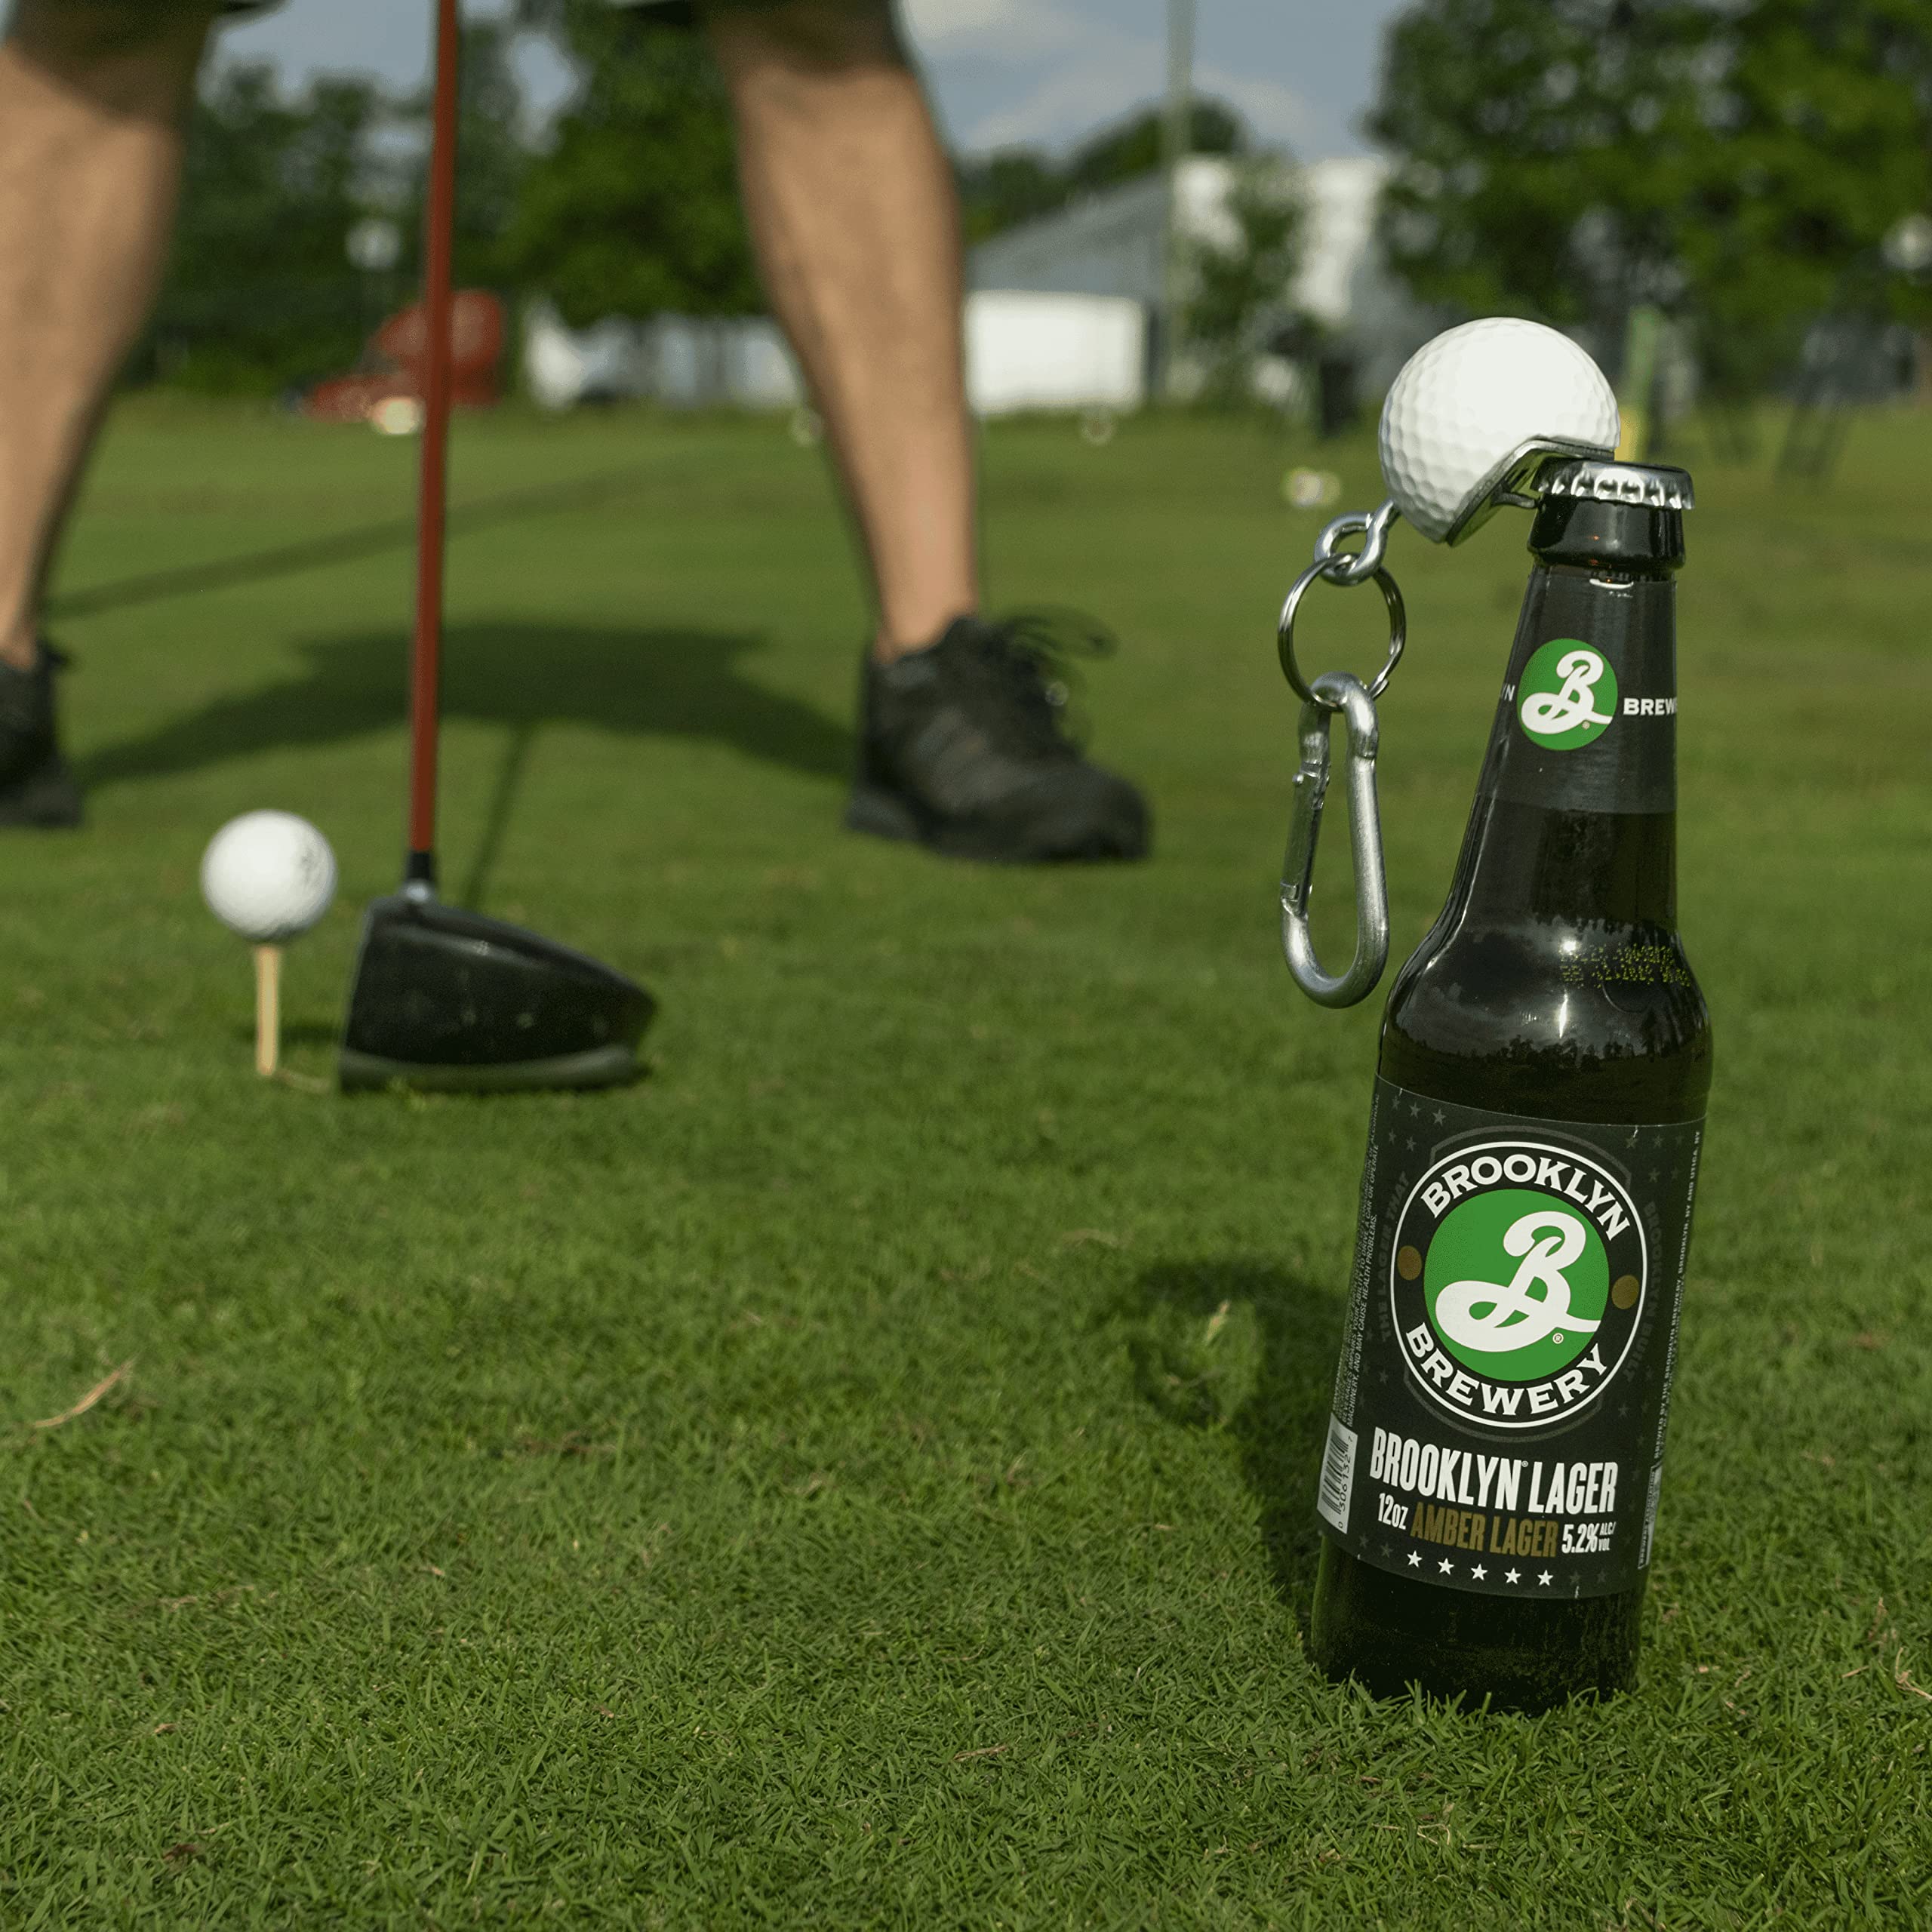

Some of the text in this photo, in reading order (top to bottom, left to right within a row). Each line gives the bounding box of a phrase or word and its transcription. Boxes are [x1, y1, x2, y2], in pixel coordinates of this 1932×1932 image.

[1420, 1154, 1630, 1241] BROOKLYN
[1361, 1264, 1371, 1300] HEALTH
[1357, 1301, 1367, 1331] CAUSE
[1352, 1352, 1361, 1372] AND
[1355, 1331, 1364, 1352] MAY
[1406, 1322, 1607, 1415] BREWERY
[1527, 1461, 1618, 1515] LAGER
[1411, 1502, 1486, 1552] AMBER
[1490, 1515, 1558, 1558] LAGER
[1561, 1523, 1600, 1553] 5.2%
